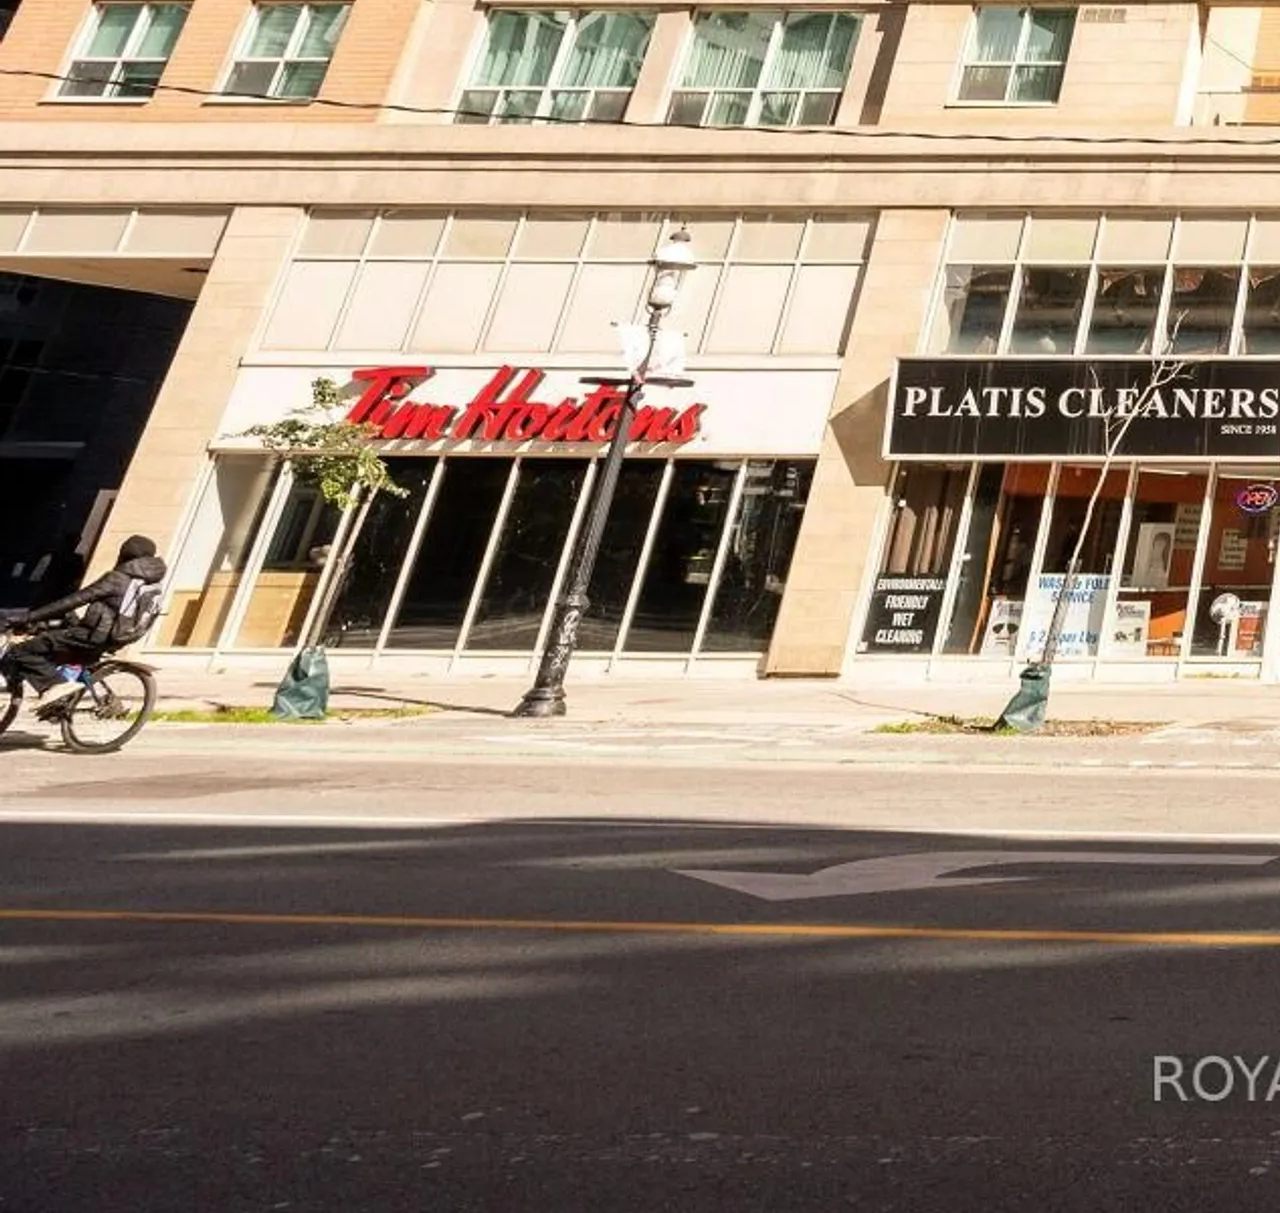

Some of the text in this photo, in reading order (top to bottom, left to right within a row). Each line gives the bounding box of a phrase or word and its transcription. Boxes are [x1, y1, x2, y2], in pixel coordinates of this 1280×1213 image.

[347, 365, 702, 441] Tim Hortons
[901, 387, 1280, 419] PLATIS CLEANERS
[1221, 424, 1252, 435] SINCE
[1240, 491, 1272, 505] OPEN
[885, 595, 928, 609] FRIENDLY
[1051, 591, 1094, 604] SRVICE
[892, 613, 914, 626] WET
[875, 629, 923, 644] CLEANING
